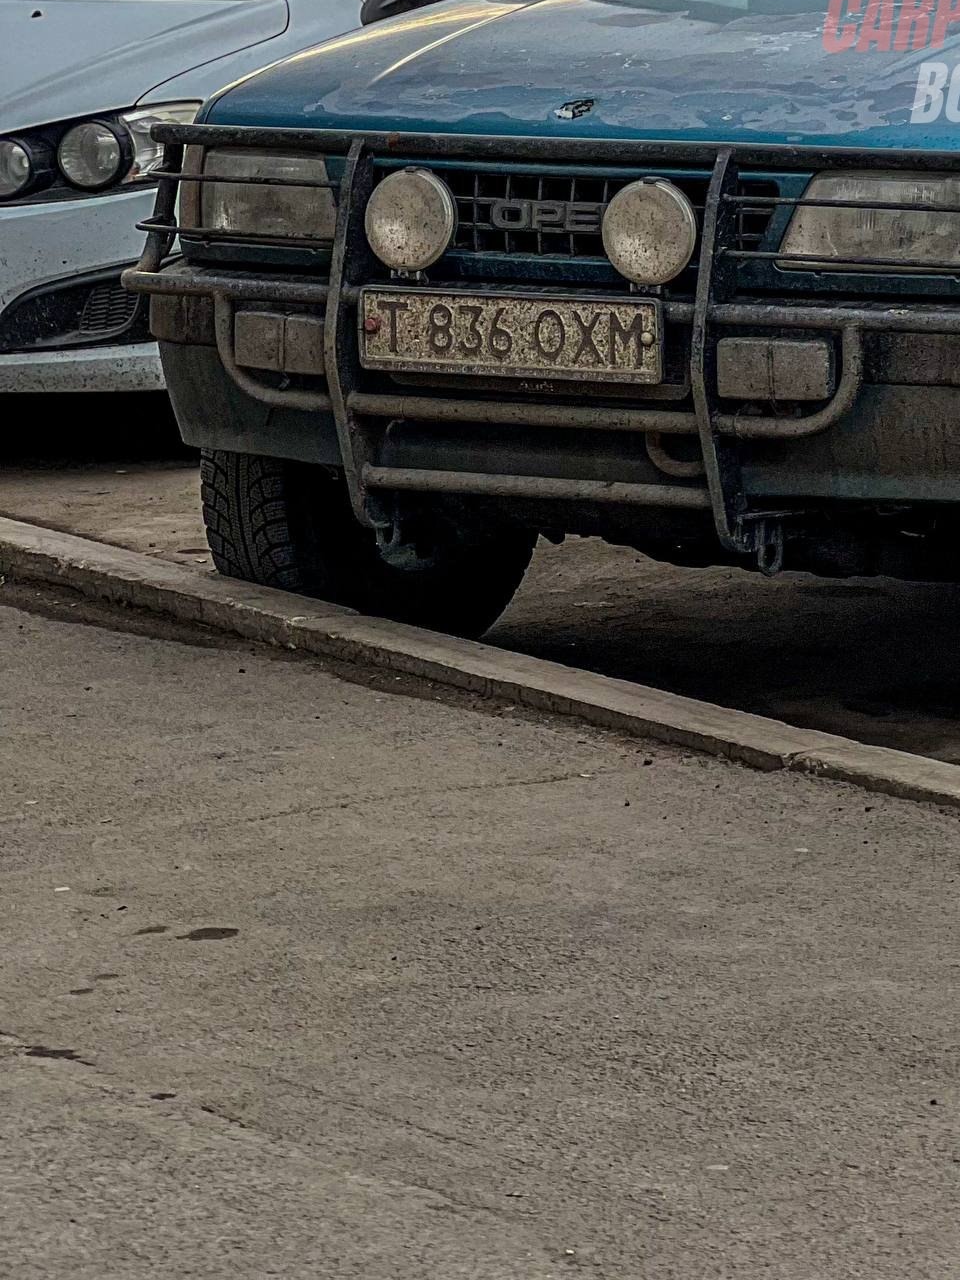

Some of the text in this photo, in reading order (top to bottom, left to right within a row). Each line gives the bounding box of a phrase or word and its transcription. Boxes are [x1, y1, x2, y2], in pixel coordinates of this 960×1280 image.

[491, 198, 601, 233] OPE
[377, 301, 643, 366] T 836 OXM
